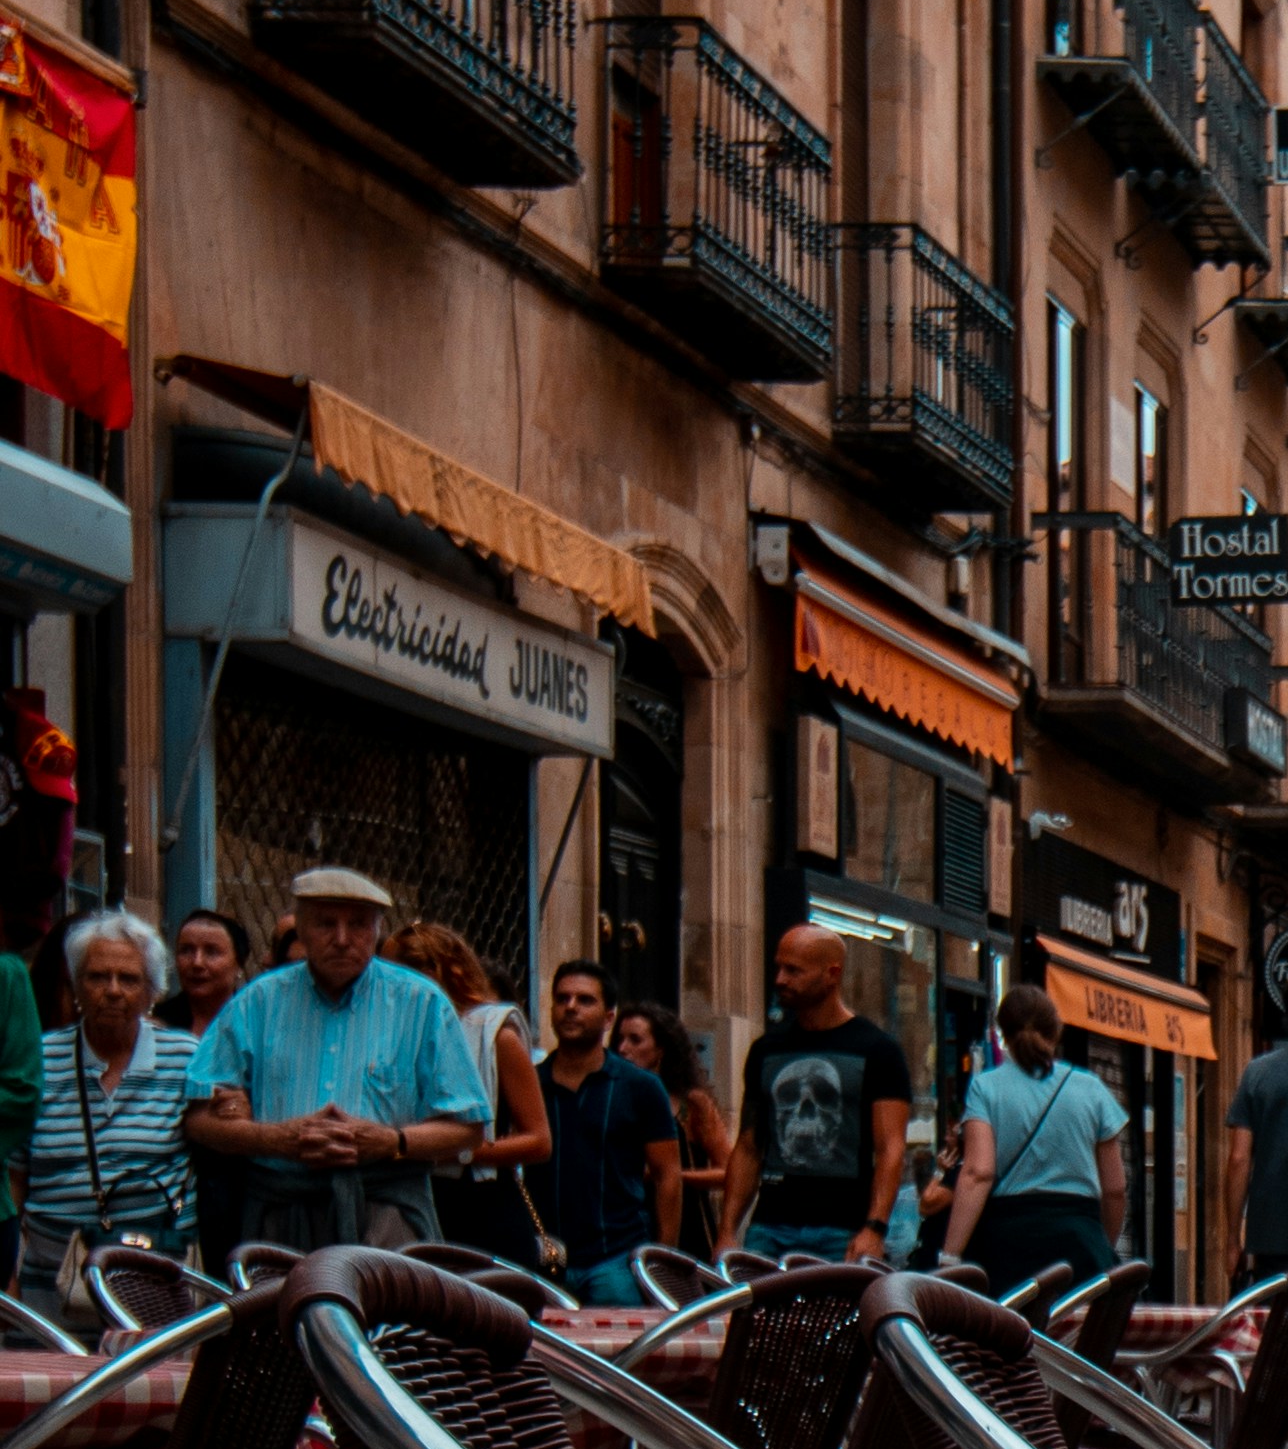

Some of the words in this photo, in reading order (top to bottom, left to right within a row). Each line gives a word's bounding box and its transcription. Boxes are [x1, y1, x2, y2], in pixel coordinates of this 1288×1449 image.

[1180, 517, 1280, 558] Hostal
[321, 554, 490, 700] Electricidad
[509, 639, 590, 723] JUANES
[1085, 984, 1149, 1036] LIBRERIA
